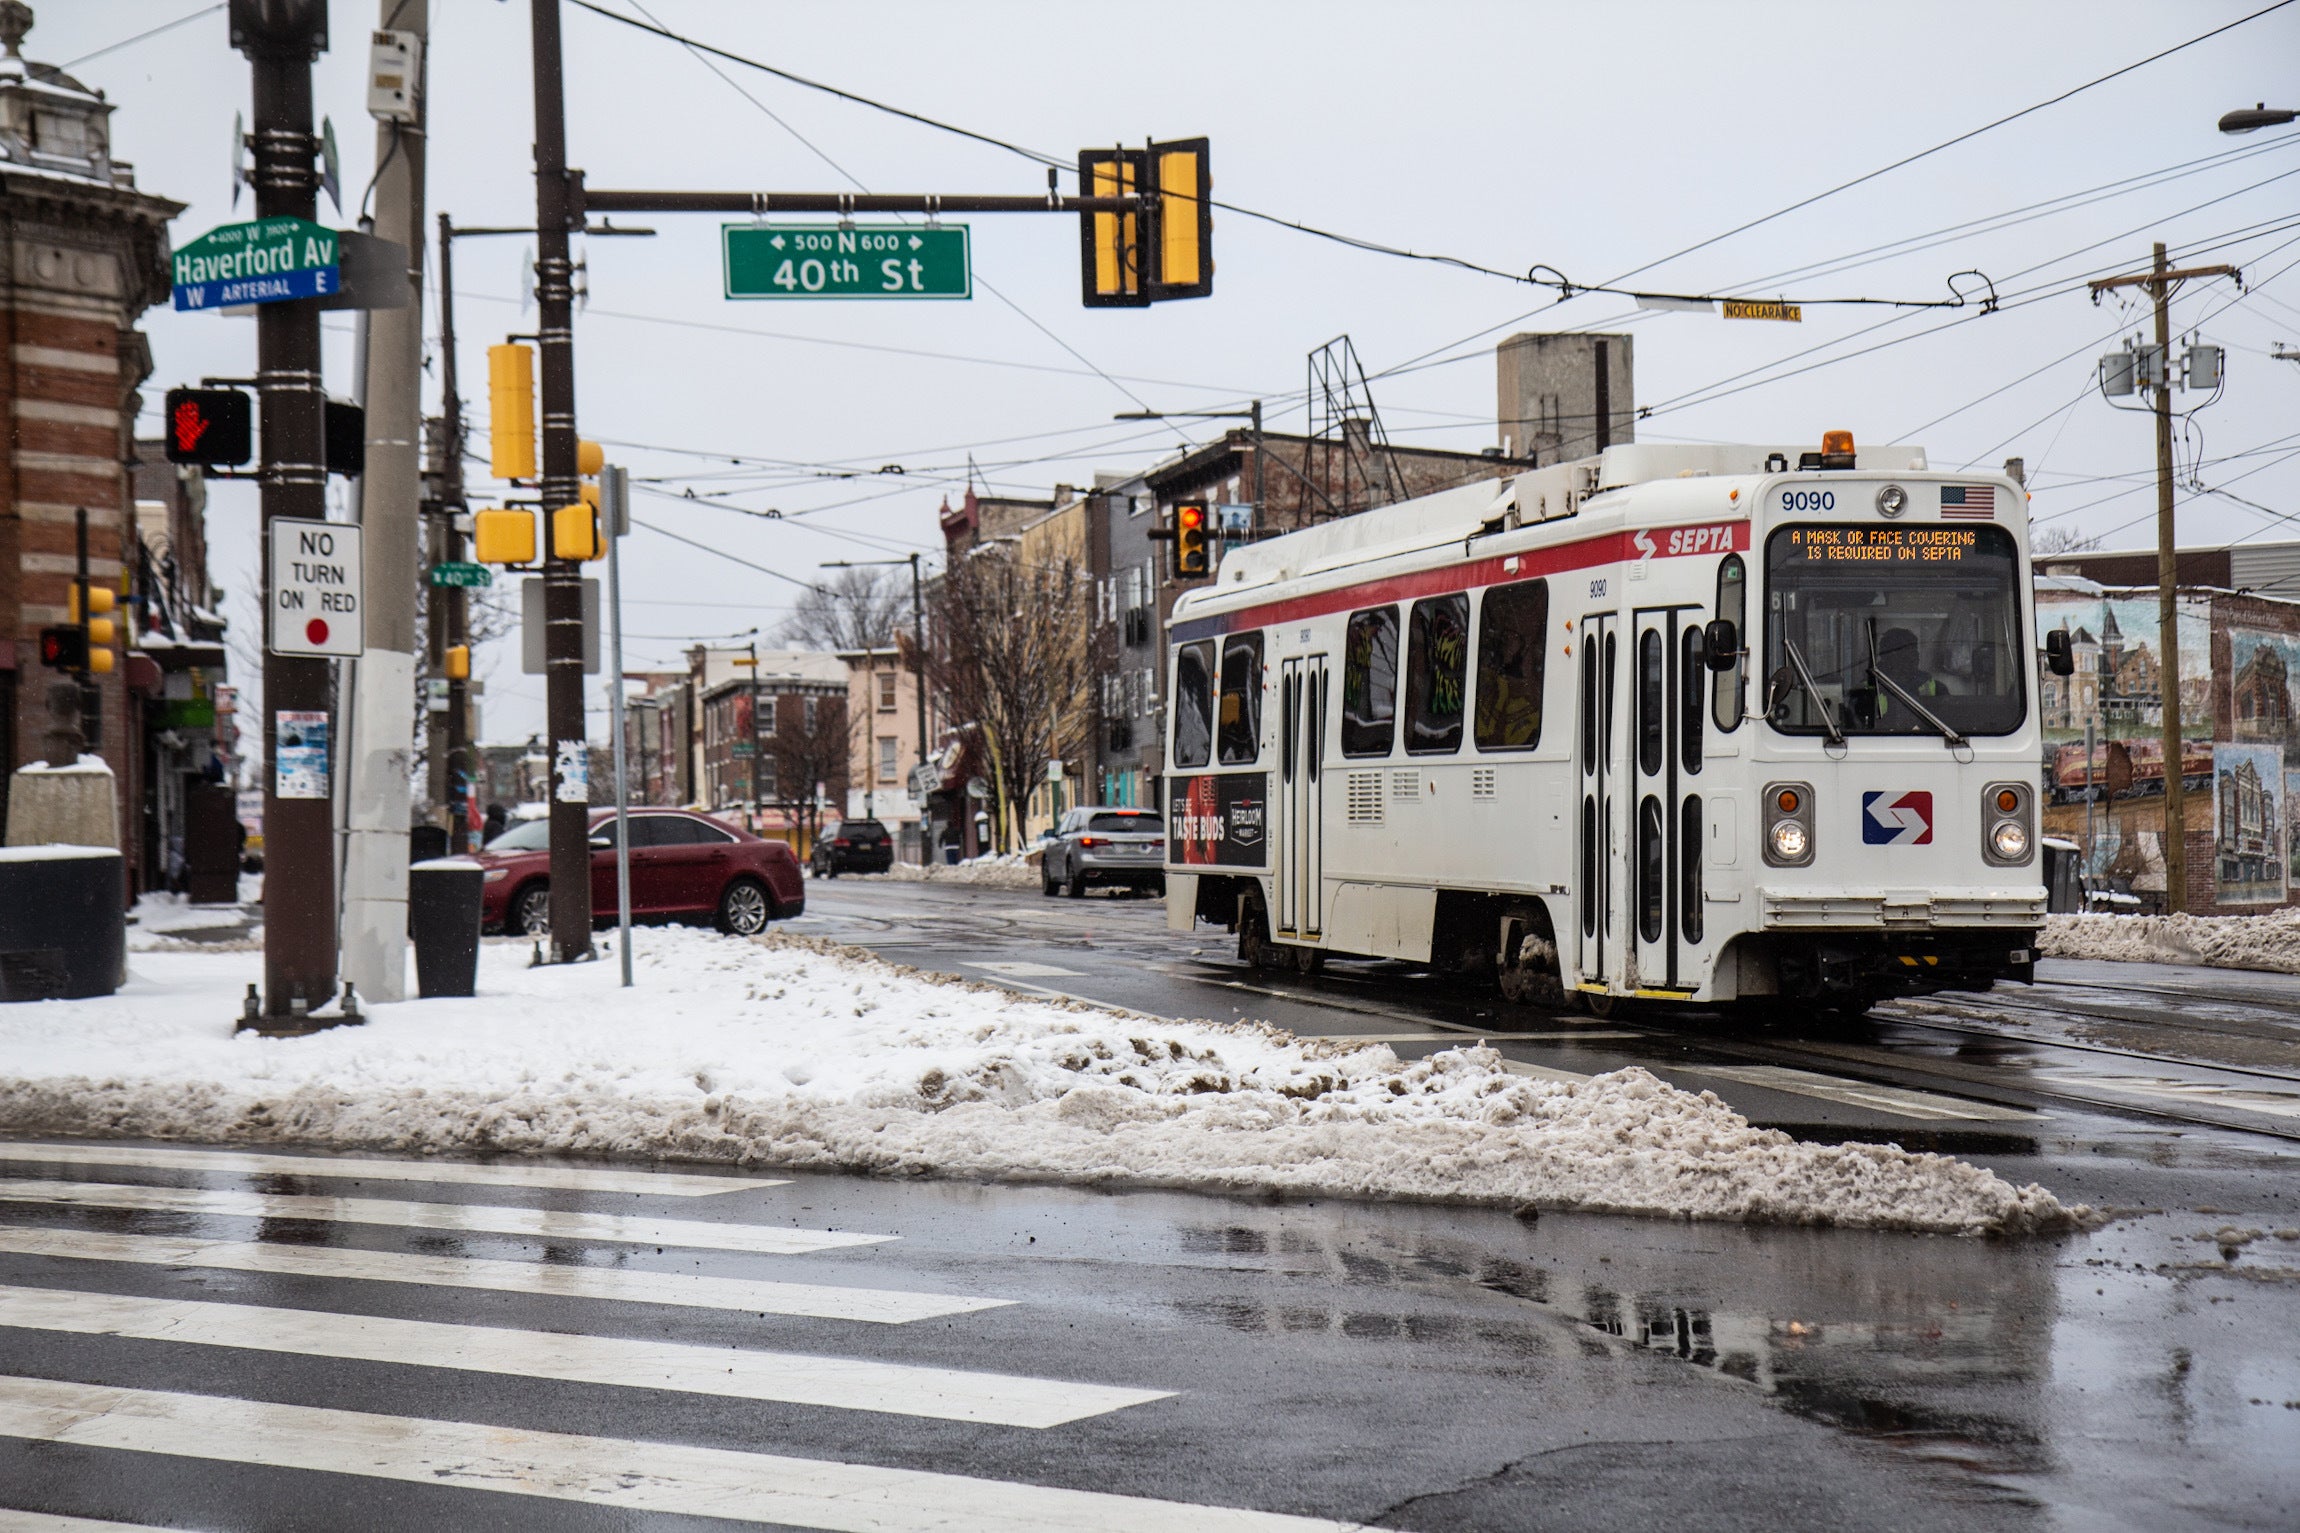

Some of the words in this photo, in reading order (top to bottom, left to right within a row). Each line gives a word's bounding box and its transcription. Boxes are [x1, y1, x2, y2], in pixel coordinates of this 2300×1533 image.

[246, 225, 260, 241] W
[795, 235, 832, 250] 500
[838, 232, 856, 254] N
[861, 235, 899, 250] 600
[176, 238, 294, 285] Haverford
[304, 236, 333, 268] Av
[773, 259, 859, 291] 40th
[881, 258, 924, 291] St
[186, 286, 205, 308] W
[221, 279, 291, 301] ARTERIAL
[315, 271, 327, 293] E
[1726, 304, 1740, 317] NO
[1744, 304, 1799, 320] CLEARANCE
[1781, 491, 1835, 511] 9090
[300, 531, 334, 556] NO
[1668, 525, 1734, 556] SEPTA
[1792, 531, 1801, 544] A
[1807, 531, 1841, 544] MASK
[1847, 531, 1864, 544] OR
[1870, 531, 1902, 544] FACE
[1908, 531, 1976, 545] COVERING
[1807, 546, 1822, 560] IS
[1828, 546, 1892, 560] REQUIRED
[1898, 546, 1916, 560] ON
[1922, 546, 1962, 560] SEPTA
[292, 562, 345, 584] TURN
[1590, 578, 1607, 599] 9090
[280, 589, 304, 609] ON
[321, 592, 356, 612] RED
[1231, 808, 1262, 826] HEIRLOOM
[1172, 816, 1198, 840] TASTE
[1200, 816, 1225, 841] BUDS
